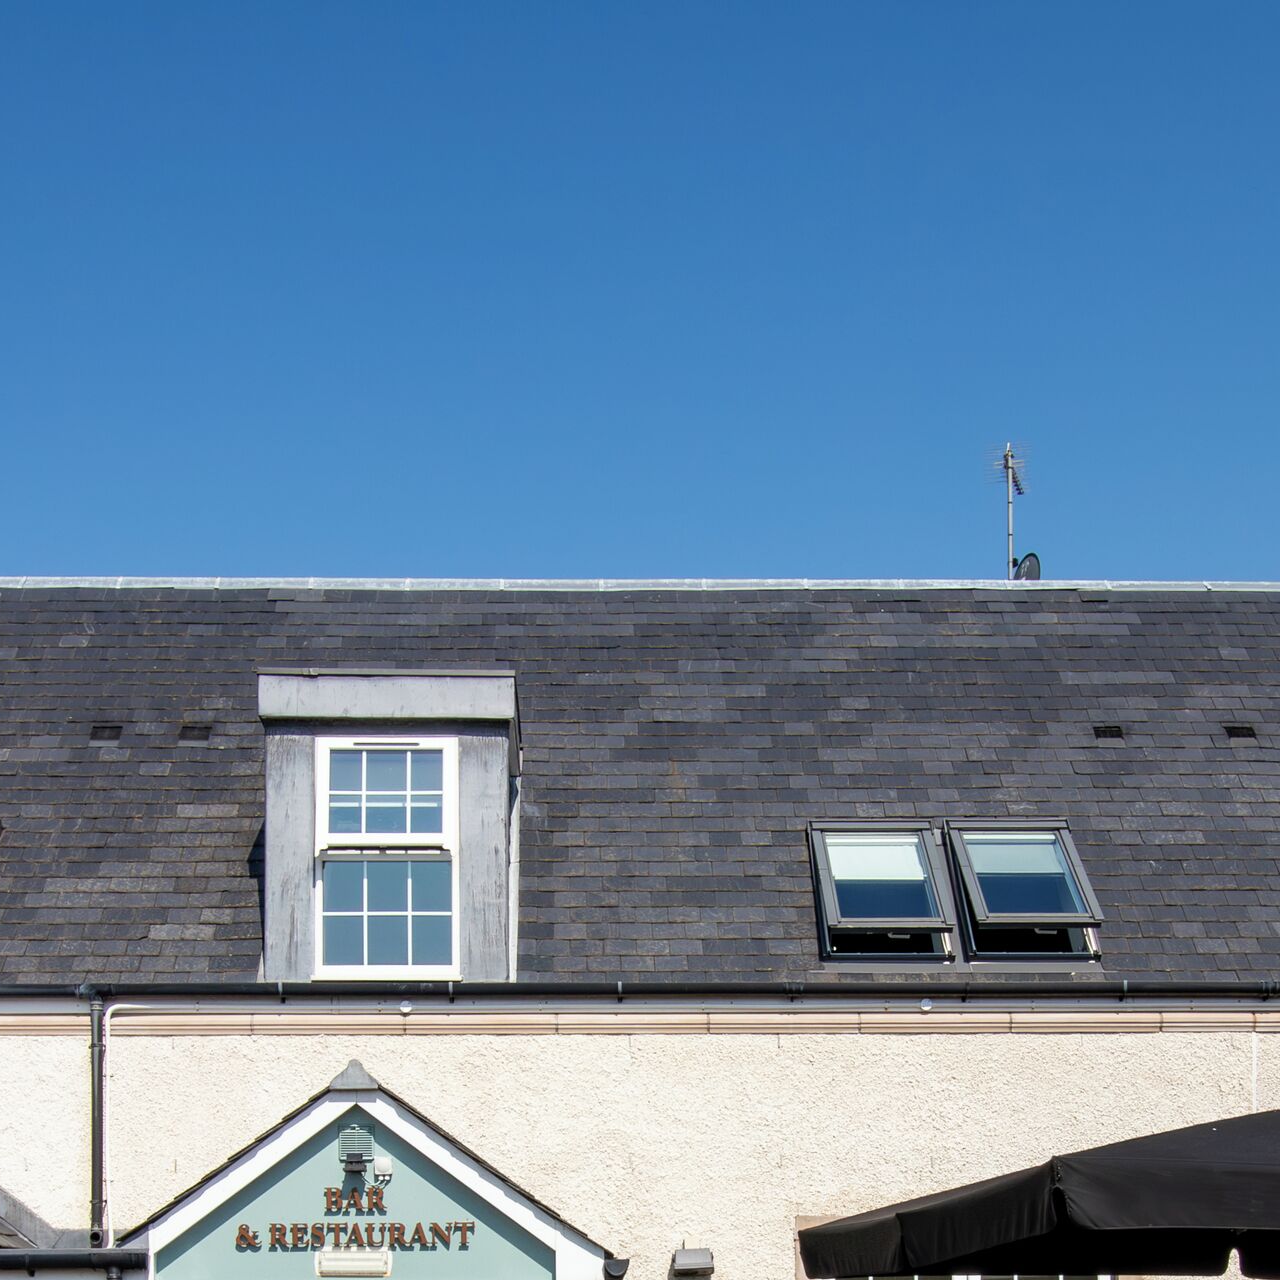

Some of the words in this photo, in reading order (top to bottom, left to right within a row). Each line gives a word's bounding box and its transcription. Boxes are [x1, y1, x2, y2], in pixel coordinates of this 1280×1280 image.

[323, 1186, 387, 1213] BAR
[235, 1223, 261, 1249] &
[269, 1220, 476, 1249] RESTAURANT
